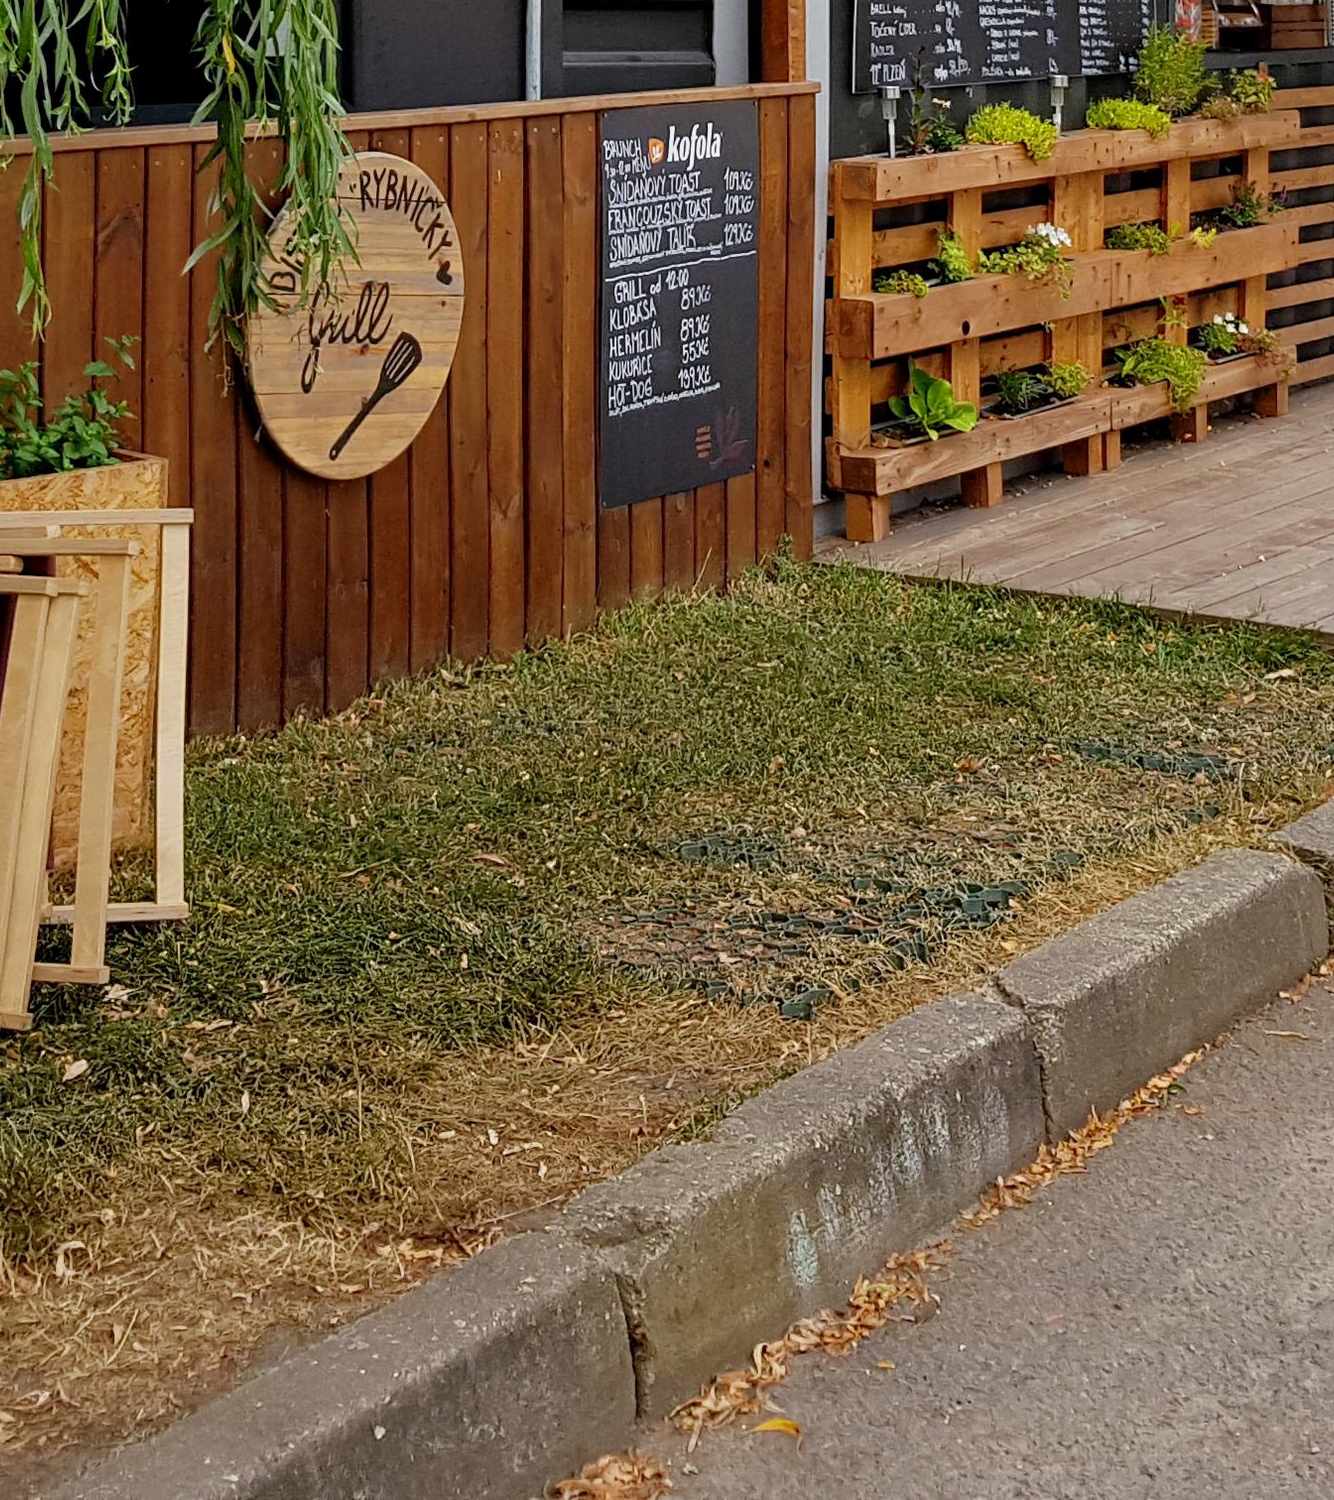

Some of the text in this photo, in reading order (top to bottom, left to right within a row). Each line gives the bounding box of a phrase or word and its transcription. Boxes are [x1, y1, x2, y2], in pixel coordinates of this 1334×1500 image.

[603, 138, 643, 161] BRUNCH
[666, 122, 722, 171] kofola
[668, 171, 701, 197] TOAST
[685, 197, 712, 219] TOAST
[614, 278, 647, 304] GRILL
[649, 274, 662, 295] od
[609, 320, 661, 359] HERMELÍN
